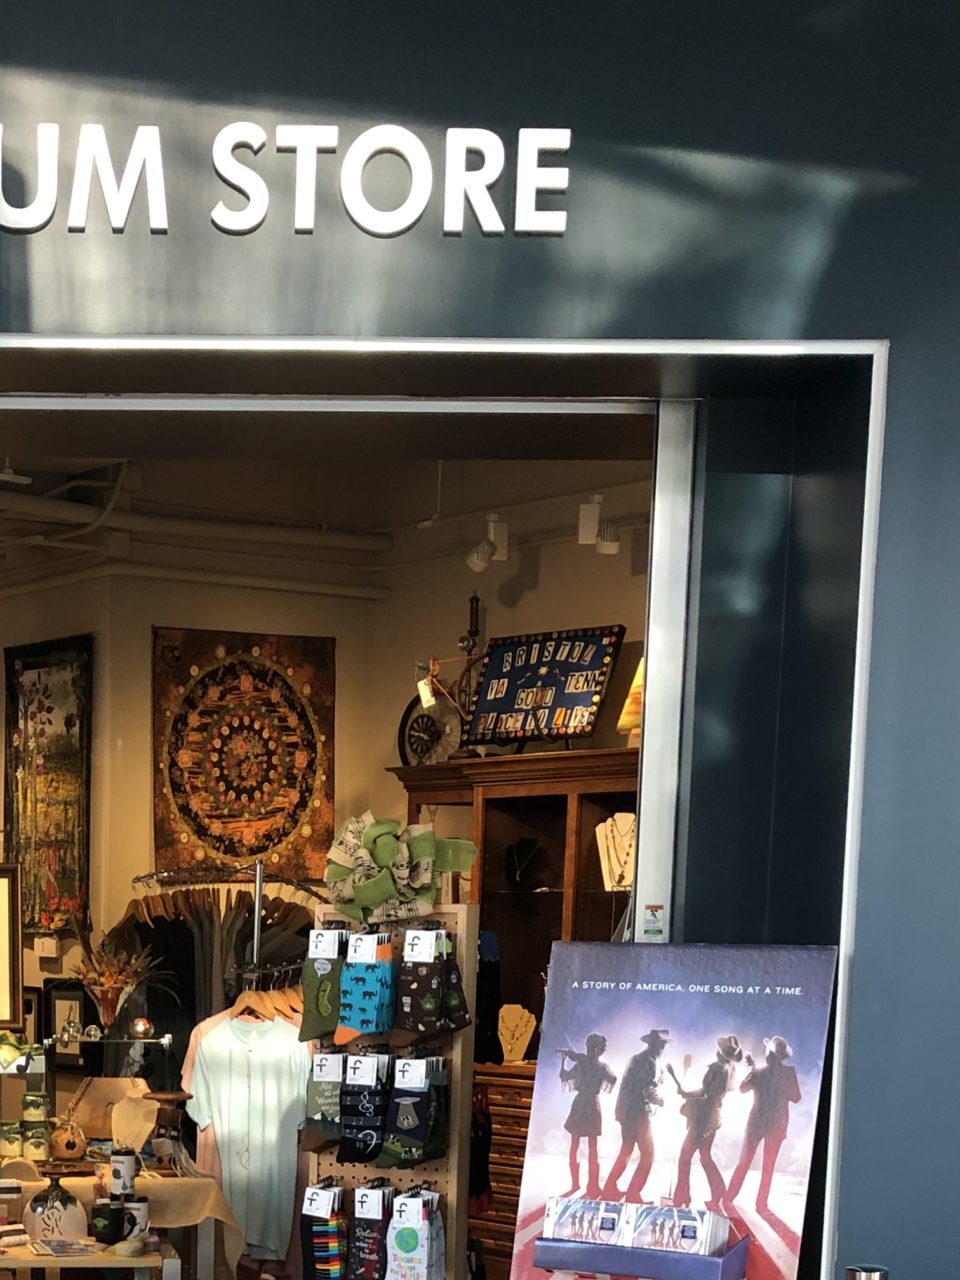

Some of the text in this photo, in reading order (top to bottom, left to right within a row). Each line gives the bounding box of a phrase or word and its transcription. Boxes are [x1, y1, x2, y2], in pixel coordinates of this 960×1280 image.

[210, 121, 572, 238] STORE
[503, 641, 597, 672] BRISTOL
[476, 711, 525, 733] PLACE
[582, 981, 616, 990] STORY
[619, 982, 632, 990] OF
[635, 983, 685, 992] AMERICA.
[689, 984, 710, 992] ONE
[713, 985, 743, 993] SONG
[746, 986, 760, 994] AT
[764, 986, 771, 994] A
[775, 987, 804, 995] TIME.
